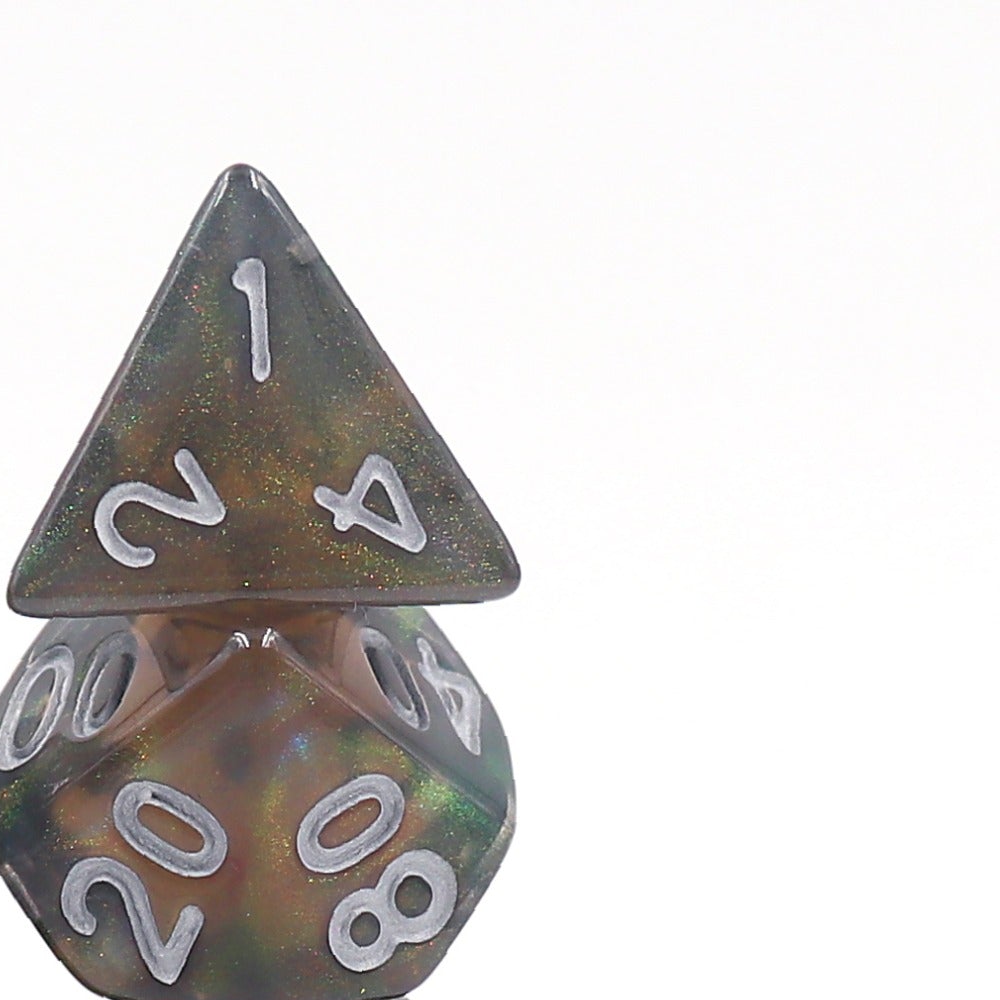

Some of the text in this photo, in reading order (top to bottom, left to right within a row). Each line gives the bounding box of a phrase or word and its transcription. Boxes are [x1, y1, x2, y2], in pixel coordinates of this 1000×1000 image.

[231, 257, 271, 382] 1
[94, 448, 226, 568] 2
[313, 454, 428, 553] 4
[60, 780, 228, 986] 20
[297, 773, 458, 973] 80
